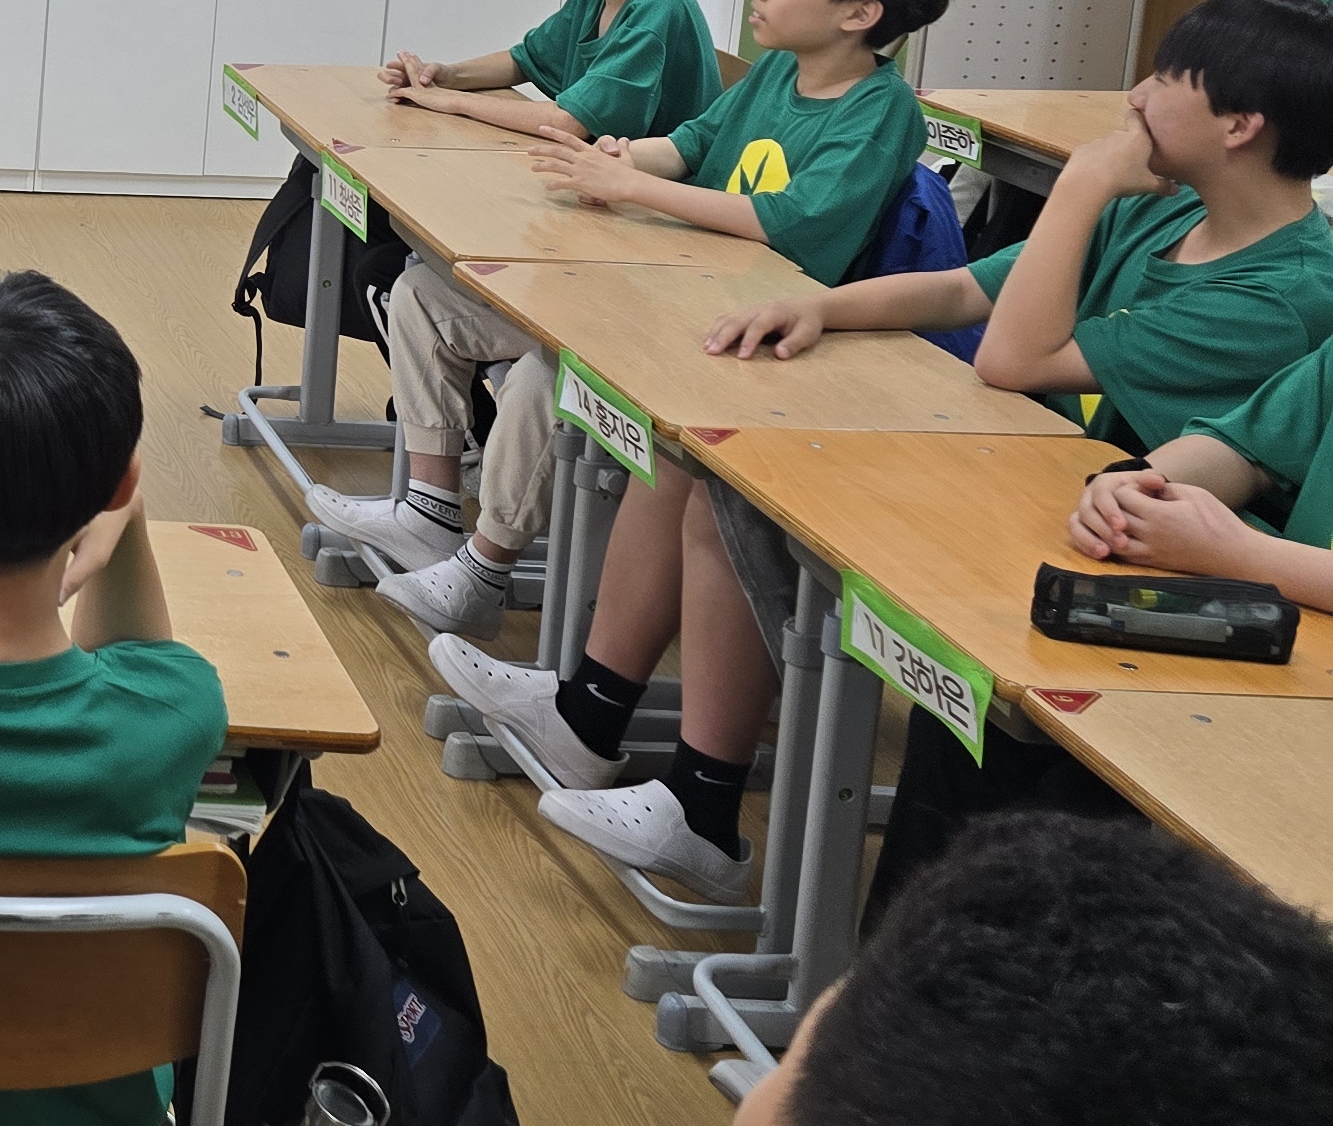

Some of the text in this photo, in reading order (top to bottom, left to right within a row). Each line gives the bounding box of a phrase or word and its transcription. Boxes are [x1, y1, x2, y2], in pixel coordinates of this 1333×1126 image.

[927, 120, 976, 156] 이준하
[573, 379, 645, 461] 14 홍지우
[409, 494, 460, 520] COVERY
